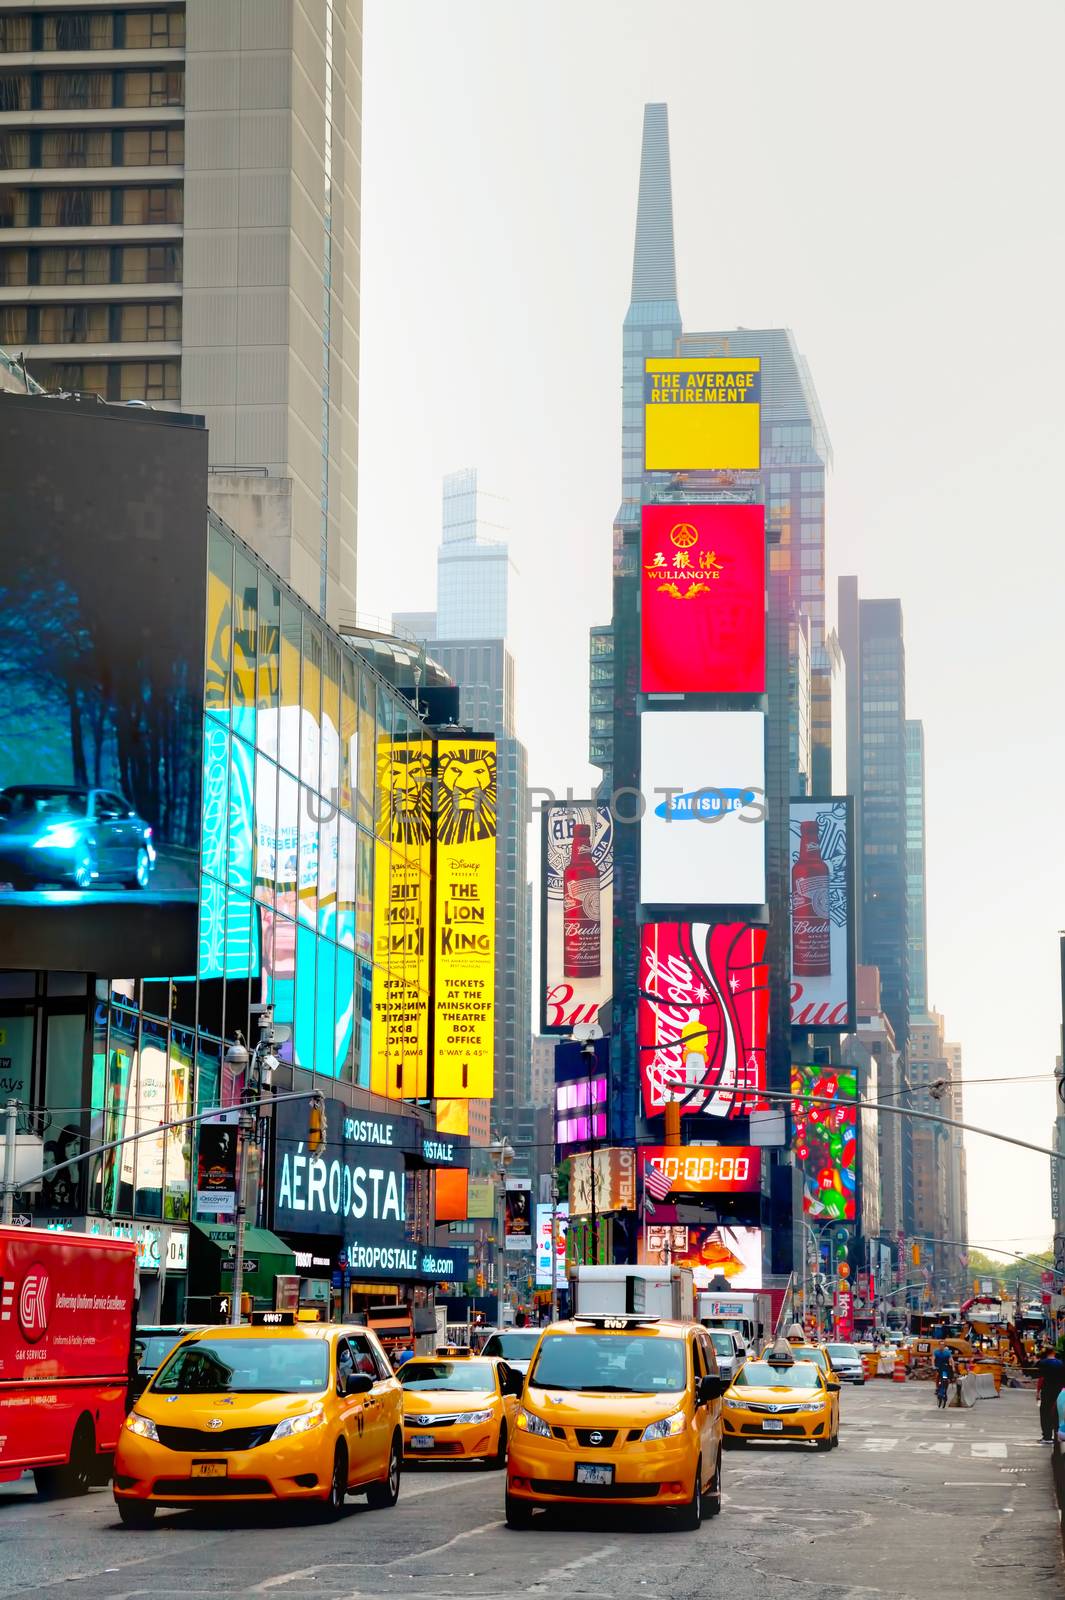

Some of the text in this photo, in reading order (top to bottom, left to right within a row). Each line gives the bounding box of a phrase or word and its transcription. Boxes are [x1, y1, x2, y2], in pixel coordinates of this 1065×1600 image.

[651, 374, 754, 387] THE AVERAGE
[651, 389, 747, 402] RETIREMENT
[647, 571, 720, 579] WULIANGYE
[669, 798, 743, 810] SAMSUNG
[446, 858, 480, 871] Disney
[449, 884, 478, 897] THE
[444, 900, 484, 925] LION
[441, 927, 490, 956] KING
[445, 980, 485, 988] TICKETS
[437, 1002, 492, 1010] MINSKOFF
[443, 1013, 487, 1021] THEATRE
[447, 1036, 482, 1044] OFFICE
[347, 1241, 417, 1270] AÉROPOSTALE
[263, 1313, 283, 1322] 4W67
[27, 1350, 47, 1359] SERVICES
